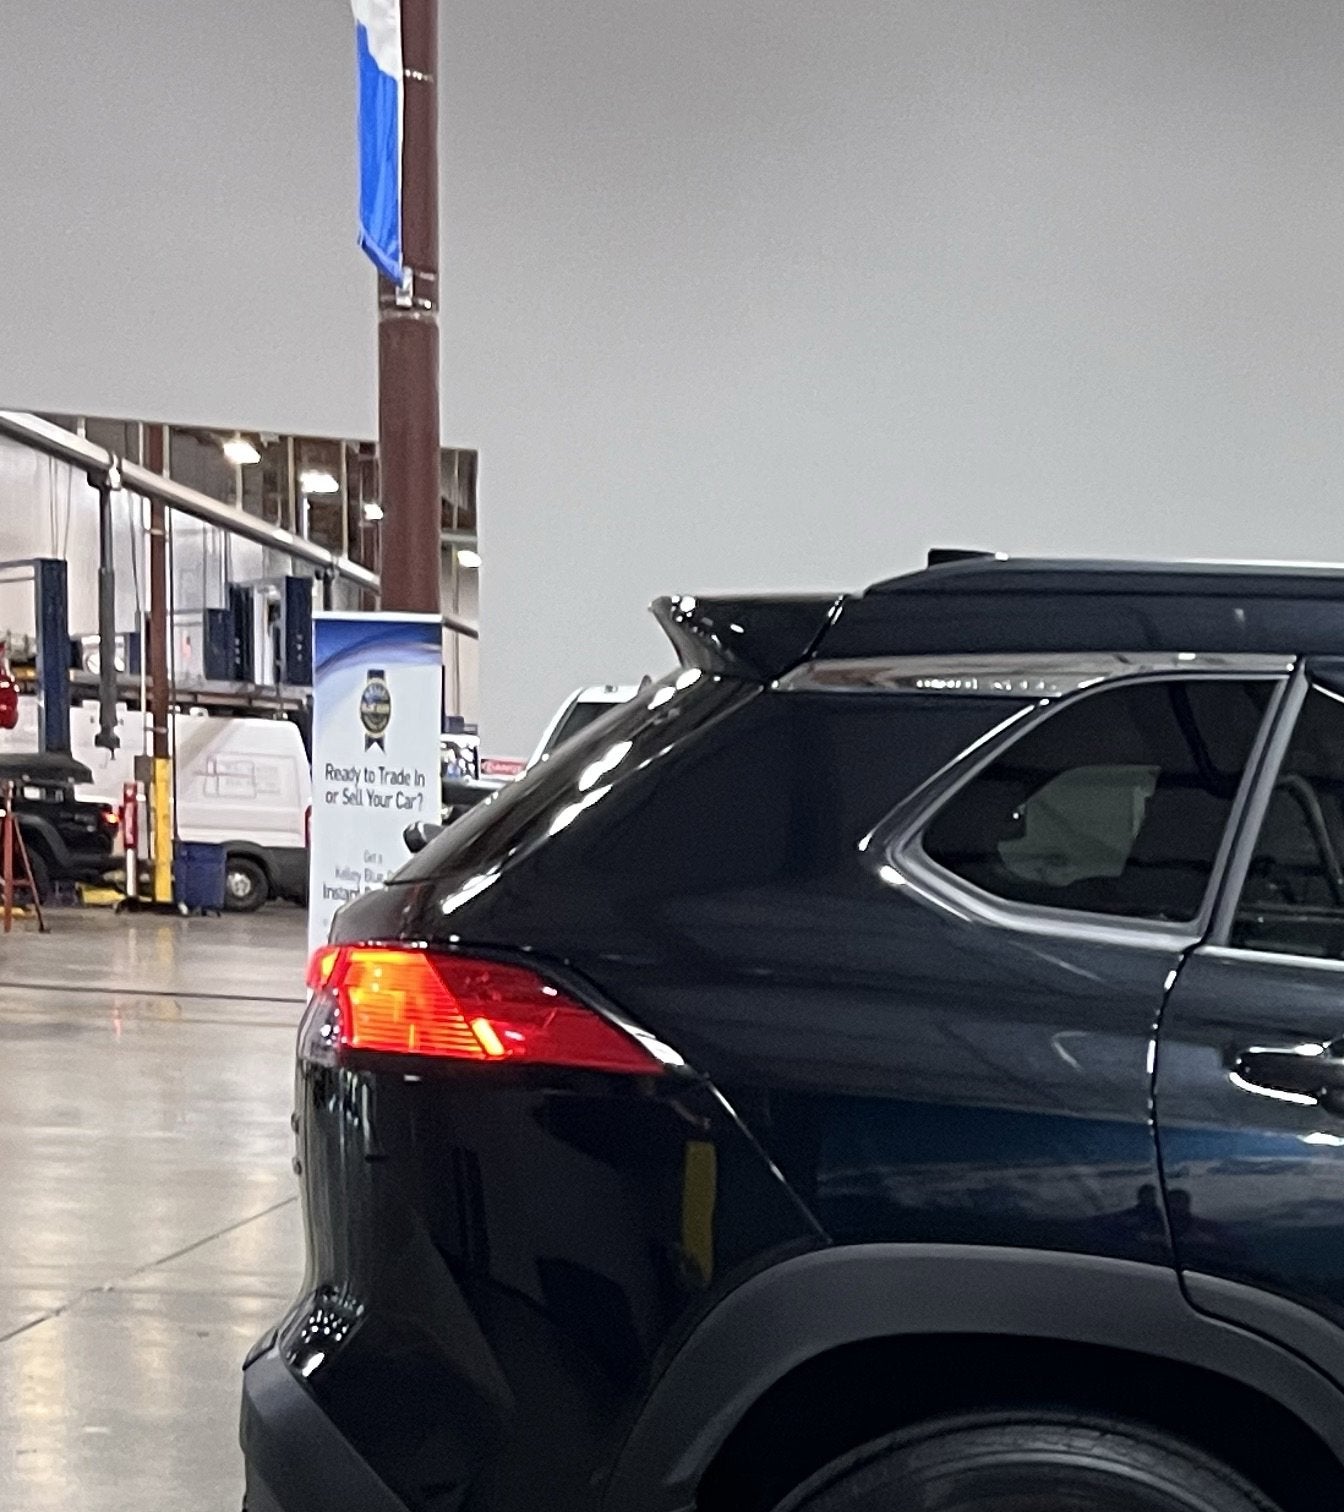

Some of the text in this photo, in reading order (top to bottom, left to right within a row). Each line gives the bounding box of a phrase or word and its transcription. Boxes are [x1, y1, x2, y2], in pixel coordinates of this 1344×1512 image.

[325, 762, 426, 788] Ready to Trade In
[325, 787, 424, 812] or Sell Your Car?
